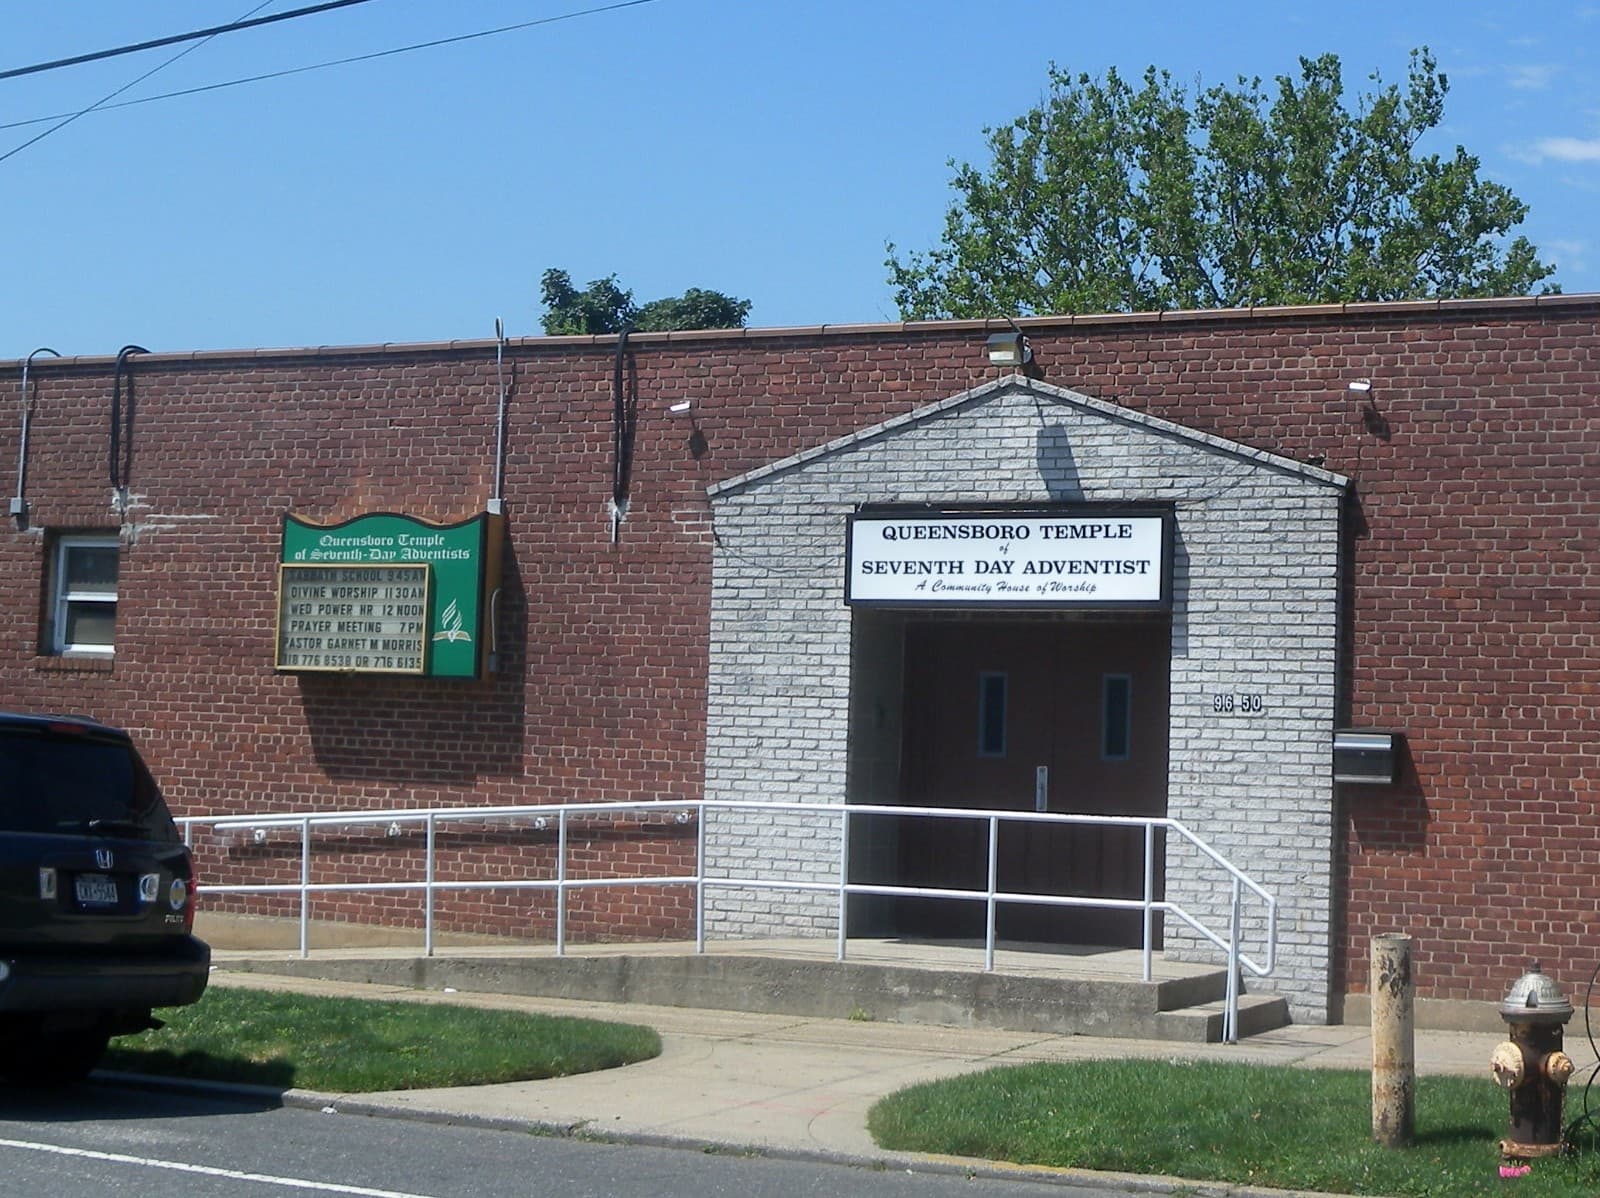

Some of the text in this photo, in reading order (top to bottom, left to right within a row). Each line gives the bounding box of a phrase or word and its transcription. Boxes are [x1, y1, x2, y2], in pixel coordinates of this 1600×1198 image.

[882, 524, 1133, 541] QUEENSBORO TEMPLE
[319, 534, 445, 547] Queensboro Temple
[294, 547, 471, 561] of Seventh-Day Adventists
[998, 542, 1010, 555] of
[861, 560, 1151, 575] SEVENTH DAY ADVENTIST
[343, 570, 383, 582] SCHOOL
[291, 586, 326, 598] DIVINE
[331, 587, 378, 598] WORSHIP
[915, 579, 1097, 594] A Community House of Worship
[291, 603, 424, 616] WED POWER HR 12 NOON
[291, 621, 332, 632] PRAYER
[337, 621, 382, 633] MEETING
[284, 637, 422, 651] PASTOR GARNET M MORRIS
[302, 655, 320, 666] 776
[355, 656, 369, 667] OR
[397, 657, 422, 668] 6135
